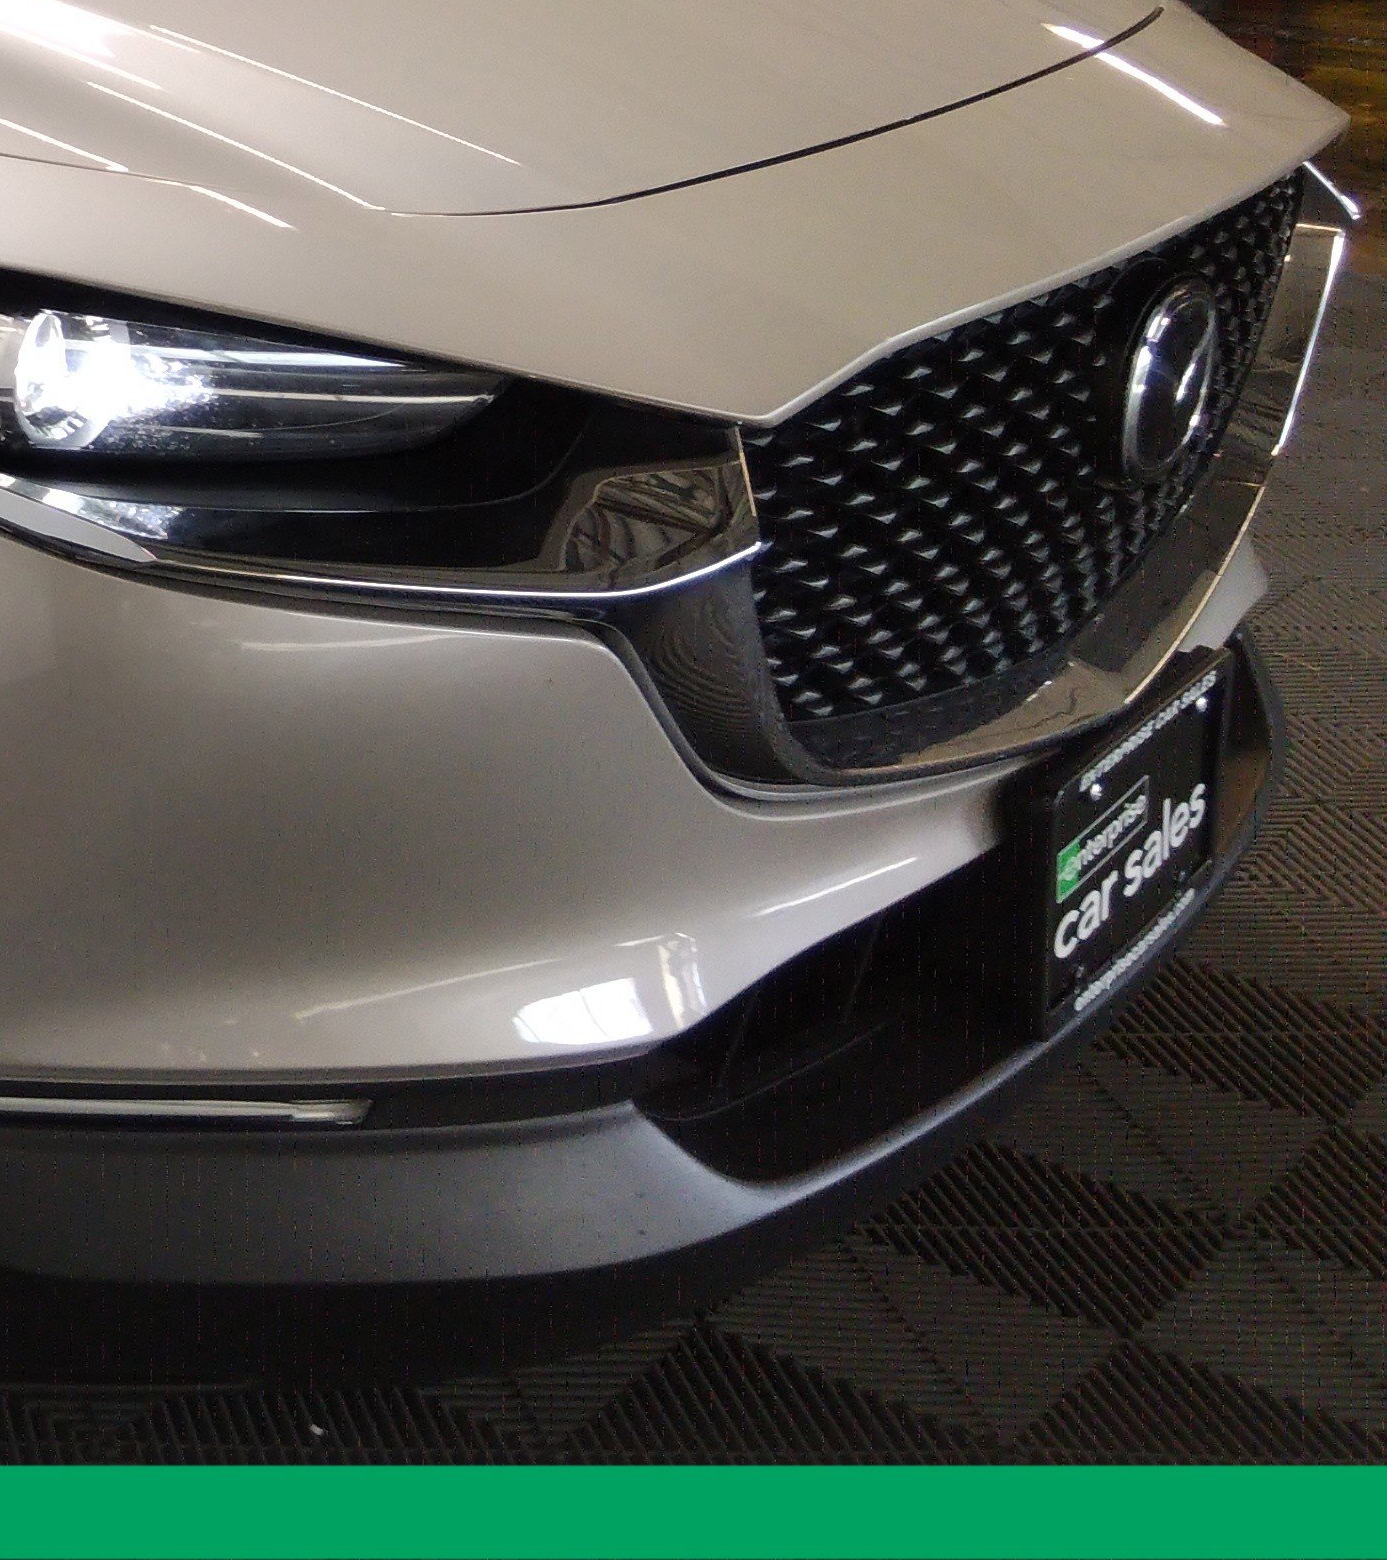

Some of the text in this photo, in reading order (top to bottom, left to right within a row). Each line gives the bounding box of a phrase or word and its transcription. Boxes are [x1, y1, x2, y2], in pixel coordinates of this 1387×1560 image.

[1053, 870, 1120, 960] car
[1123, 782, 1207, 897] sales
[1058, 794, 1147, 881] enterprise
